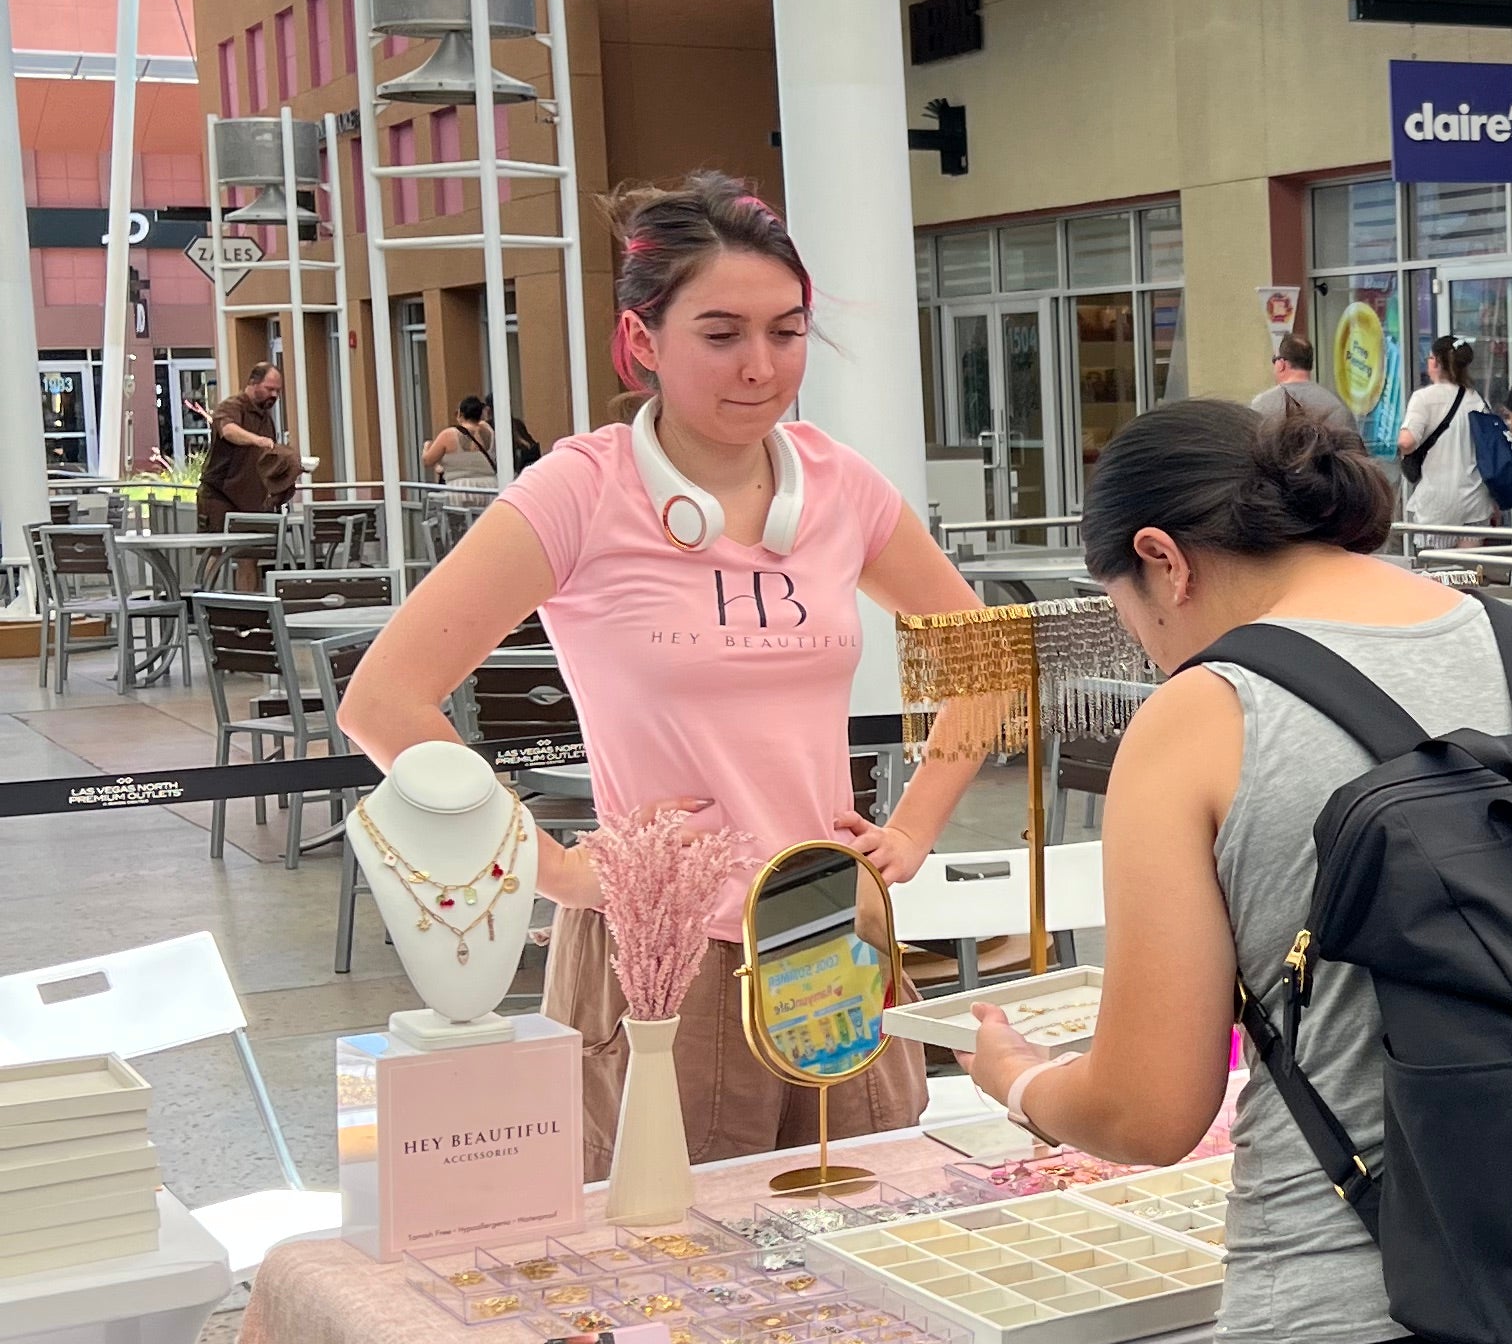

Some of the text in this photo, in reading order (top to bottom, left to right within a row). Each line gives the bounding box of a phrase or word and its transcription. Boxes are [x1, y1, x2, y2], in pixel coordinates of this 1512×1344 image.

[651, 631, 858, 649] HEY BEAUTIFUL
[498, 743, 585, 758] LAS VEGAS NORT
[546, 751, 587, 760] OUTLET
[68, 794, 126, 804] PREMIUM
[127, 789, 182, 799] OUTLETS
[71, 782, 179, 796] LAS VEGAS NORTH
[404, 1120, 560, 1155] HEY BEAUTIFUL
[443, 1146, 519, 1165] ACCESSORIES
